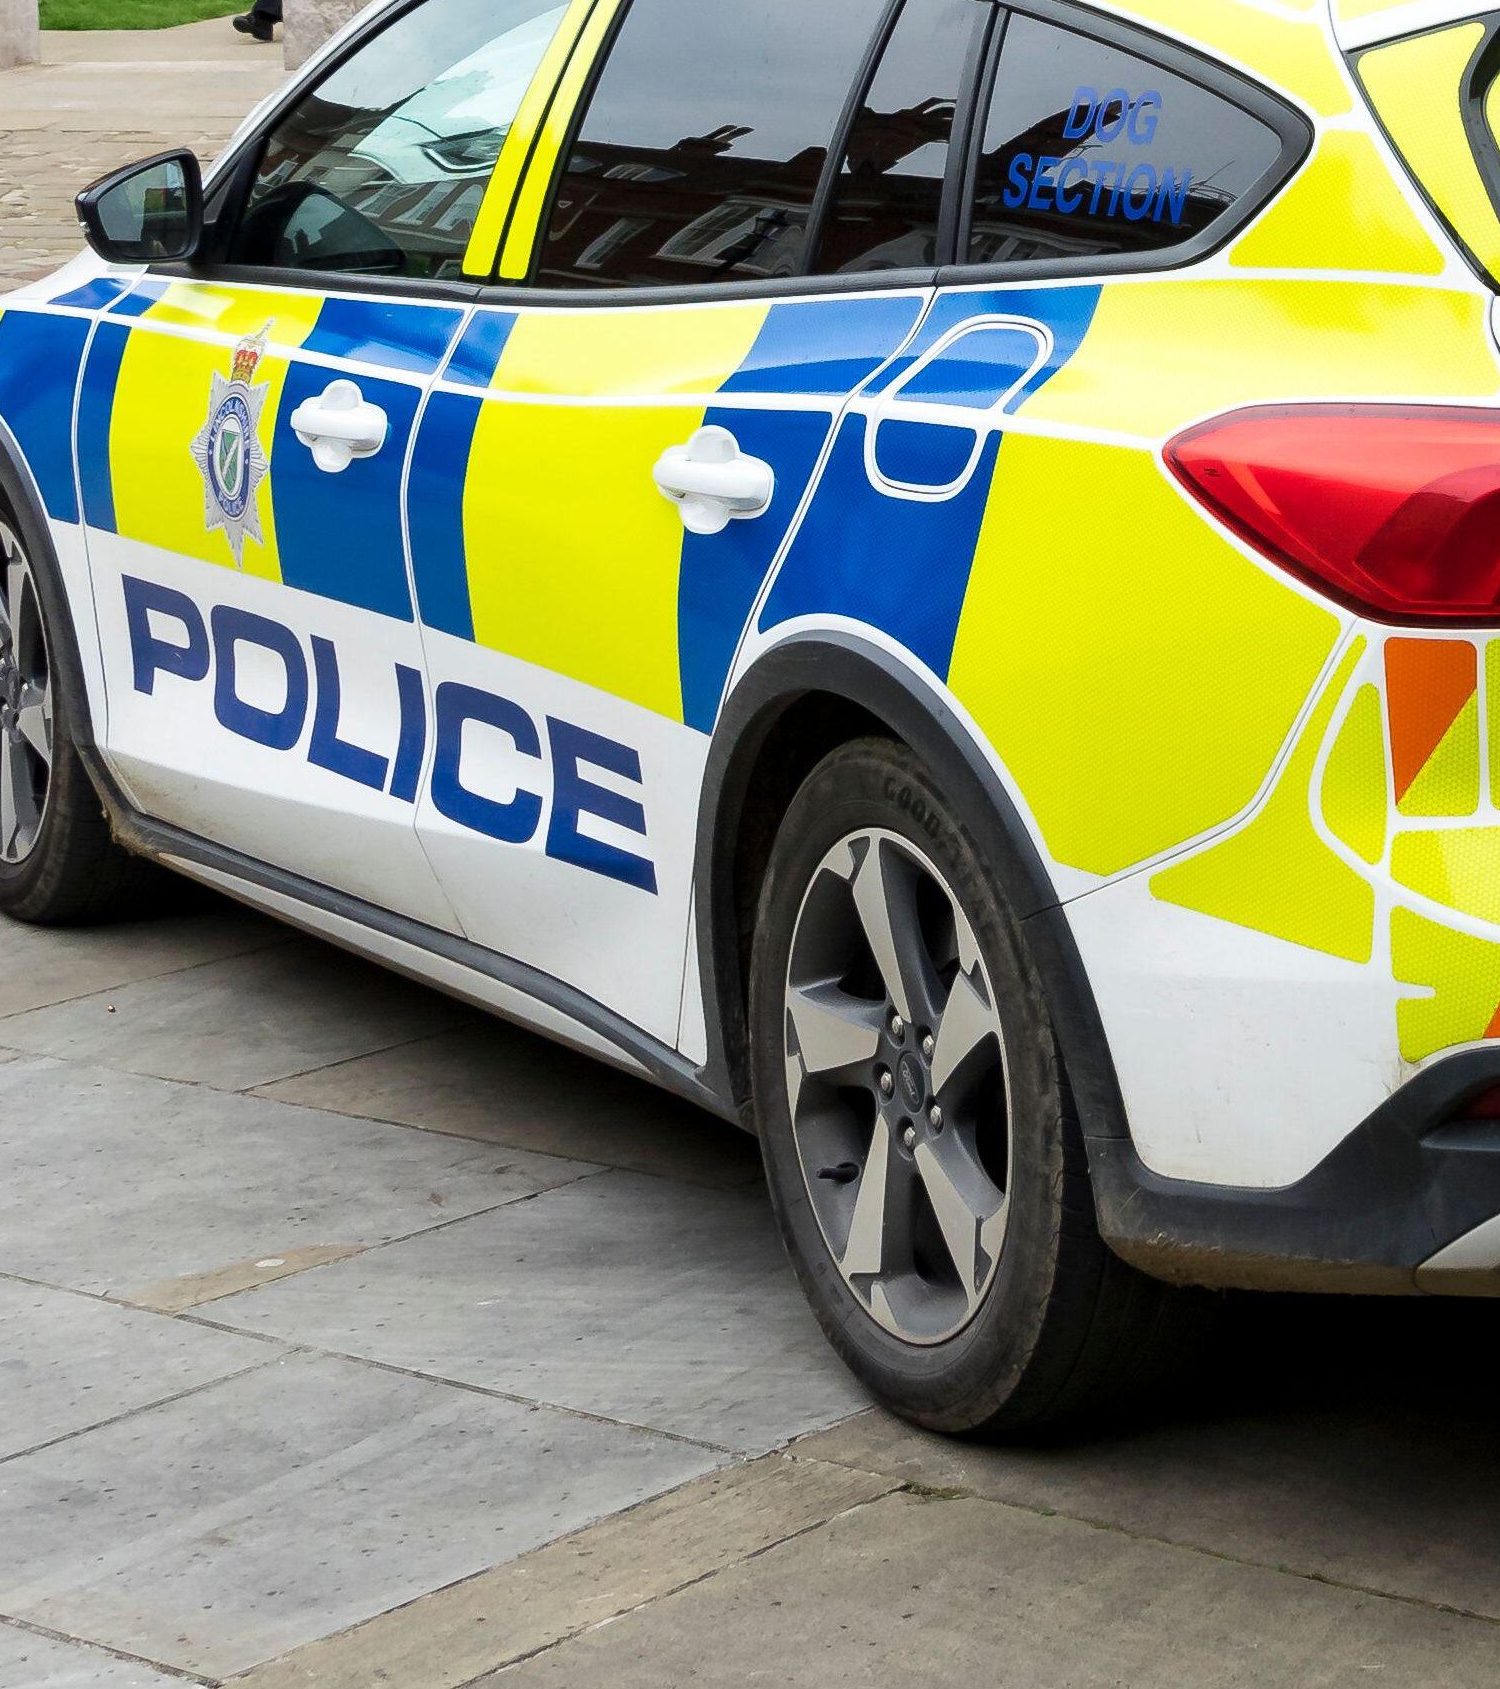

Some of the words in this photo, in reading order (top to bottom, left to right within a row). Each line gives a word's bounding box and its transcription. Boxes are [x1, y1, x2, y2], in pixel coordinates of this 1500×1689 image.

[1062, 86, 1163, 145] DOG
[1002, 152, 1194, 224] SECTION
[121, 573, 659, 896] POLICE
